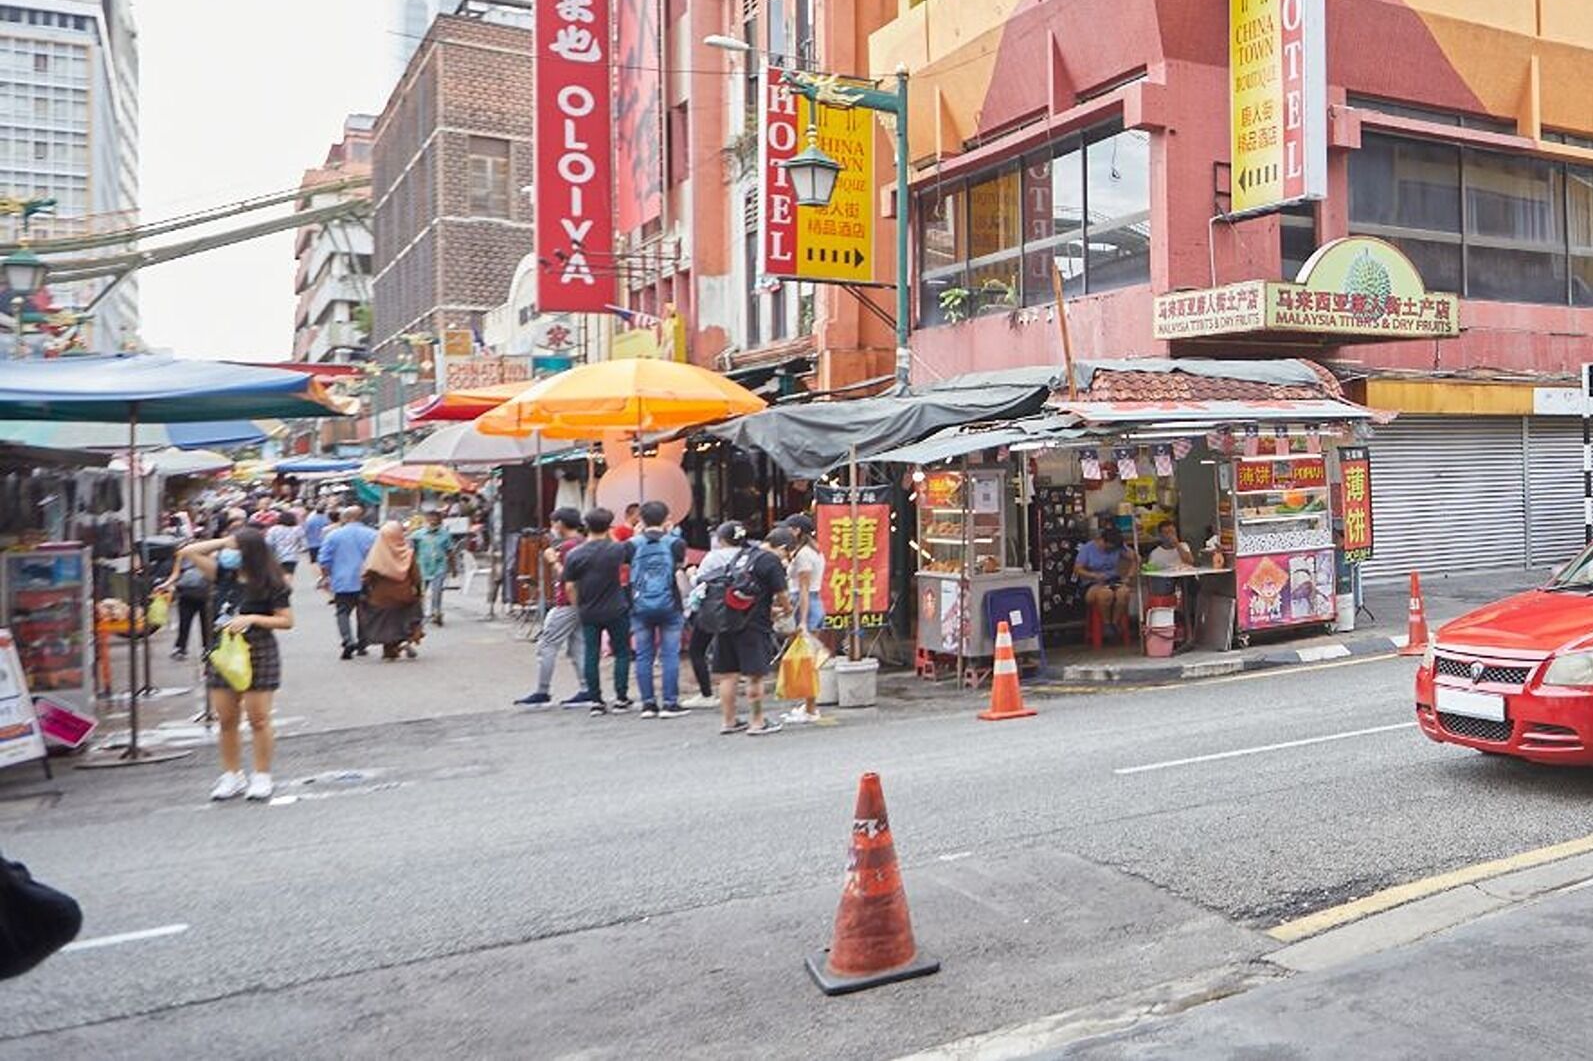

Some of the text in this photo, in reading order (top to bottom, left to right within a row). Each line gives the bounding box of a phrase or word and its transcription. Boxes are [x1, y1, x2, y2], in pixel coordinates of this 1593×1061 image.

[1235, 14, 1274, 45] CHINA
[1238, 36, 1274, 66] TOWN
[819, 136, 865, 156] HINA
[768, 84, 797, 261] HOTEL
[1275, 311, 1337, 326] MALAYSIA
[1381, 317, 1392, 329] &
[1392, 318, 1414, 331] DRY
[1416, 320, 1452, 333] FRUITS
[1345, 466, 1366, 543] 薄饼
[829, 515, 878, 613] 薄饼
[824, 613, 883, 629] POPAH
